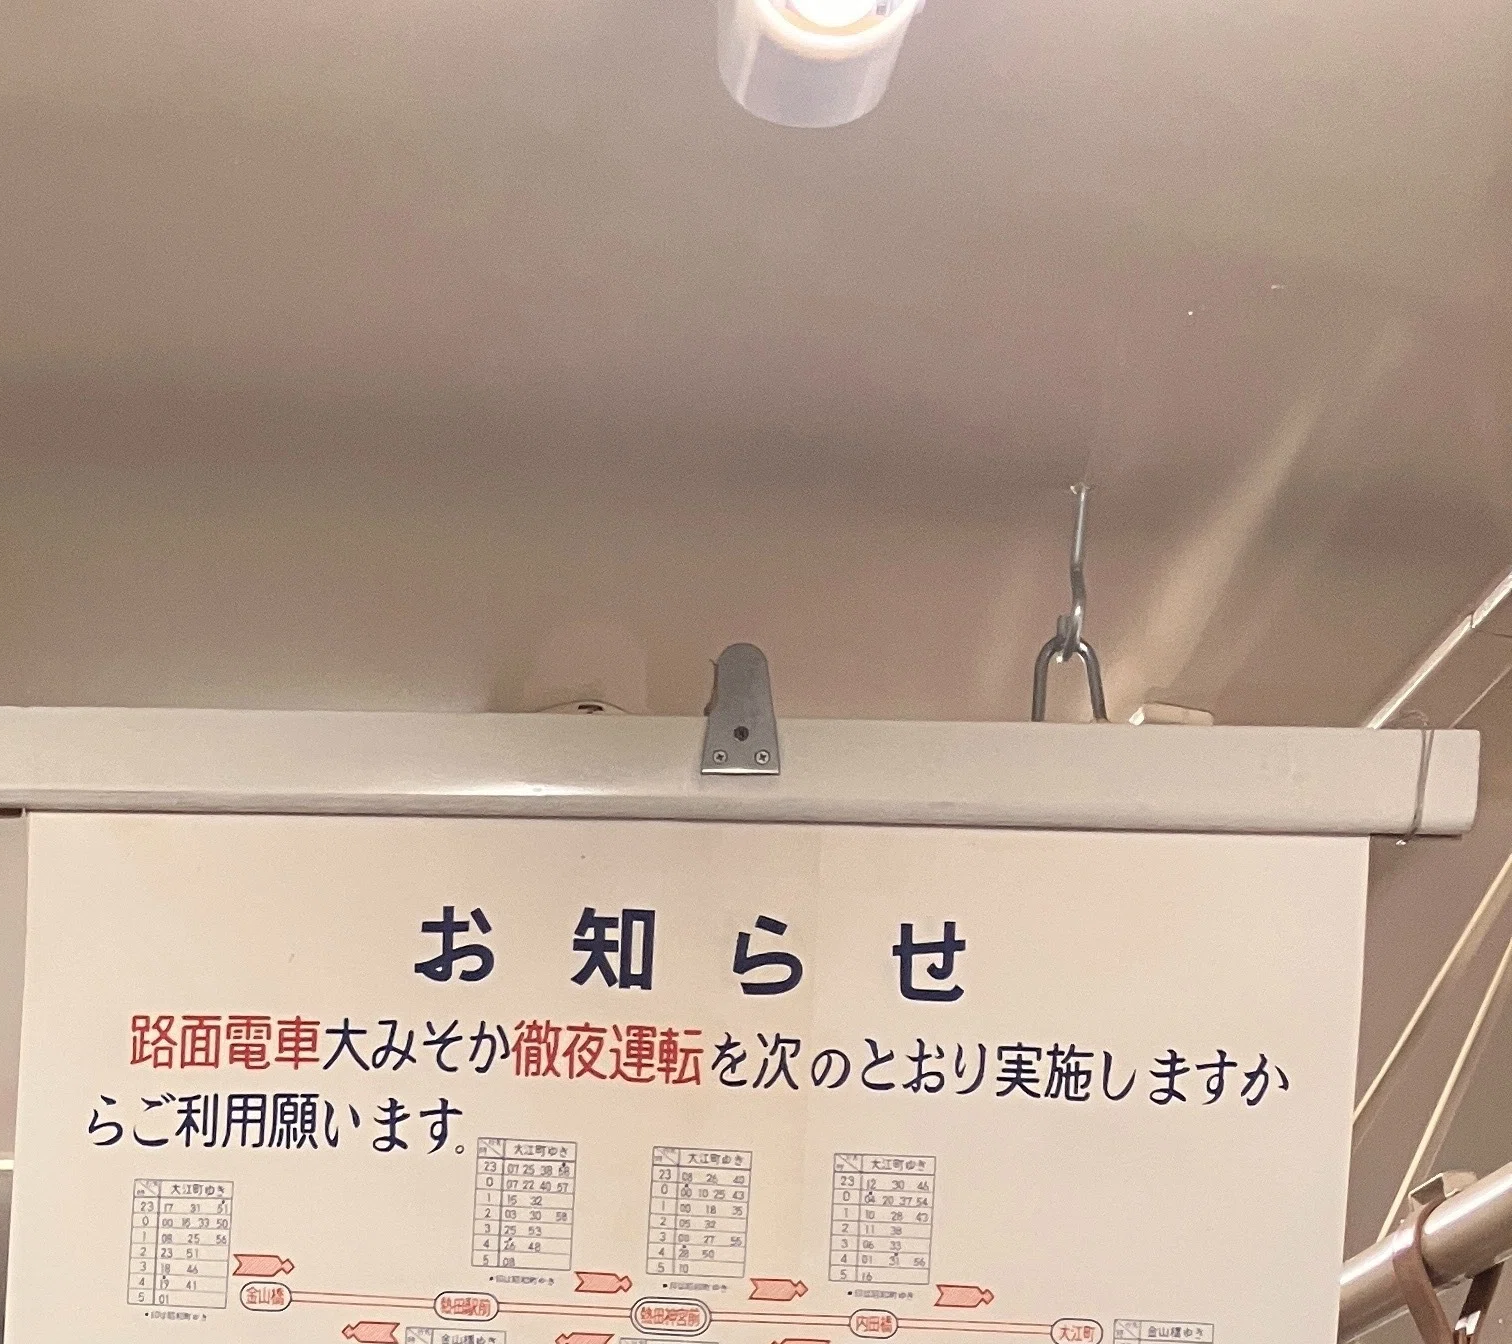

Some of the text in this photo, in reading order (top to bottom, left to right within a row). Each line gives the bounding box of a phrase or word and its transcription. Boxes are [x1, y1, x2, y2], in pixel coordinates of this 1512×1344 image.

[413, 905, 966, 1002] お知らせ
[87, 1092, 465, 1155] らご利用願います。
[484, 1161, 497, 1172] 23
[658, 1169, 672, 1180] 23
[485, 1176, 494, 1187] 0
[840, 1176, 855, 1186] 23
[842, 1191, 850, 1201] 0
[140, 1201, 154, 1212] 23
[142, 1216, 149, 1226] 0
[142, 1231, 146, 1241] 1
[139, 1247, 147, 1257] 2
[139, 1261, 147, 1272] 3
[139, 1277, 145, 1286] 4
[138, 1292, 145, 1302] 5
[1059, 1326, 1095, 1343] 大江町
